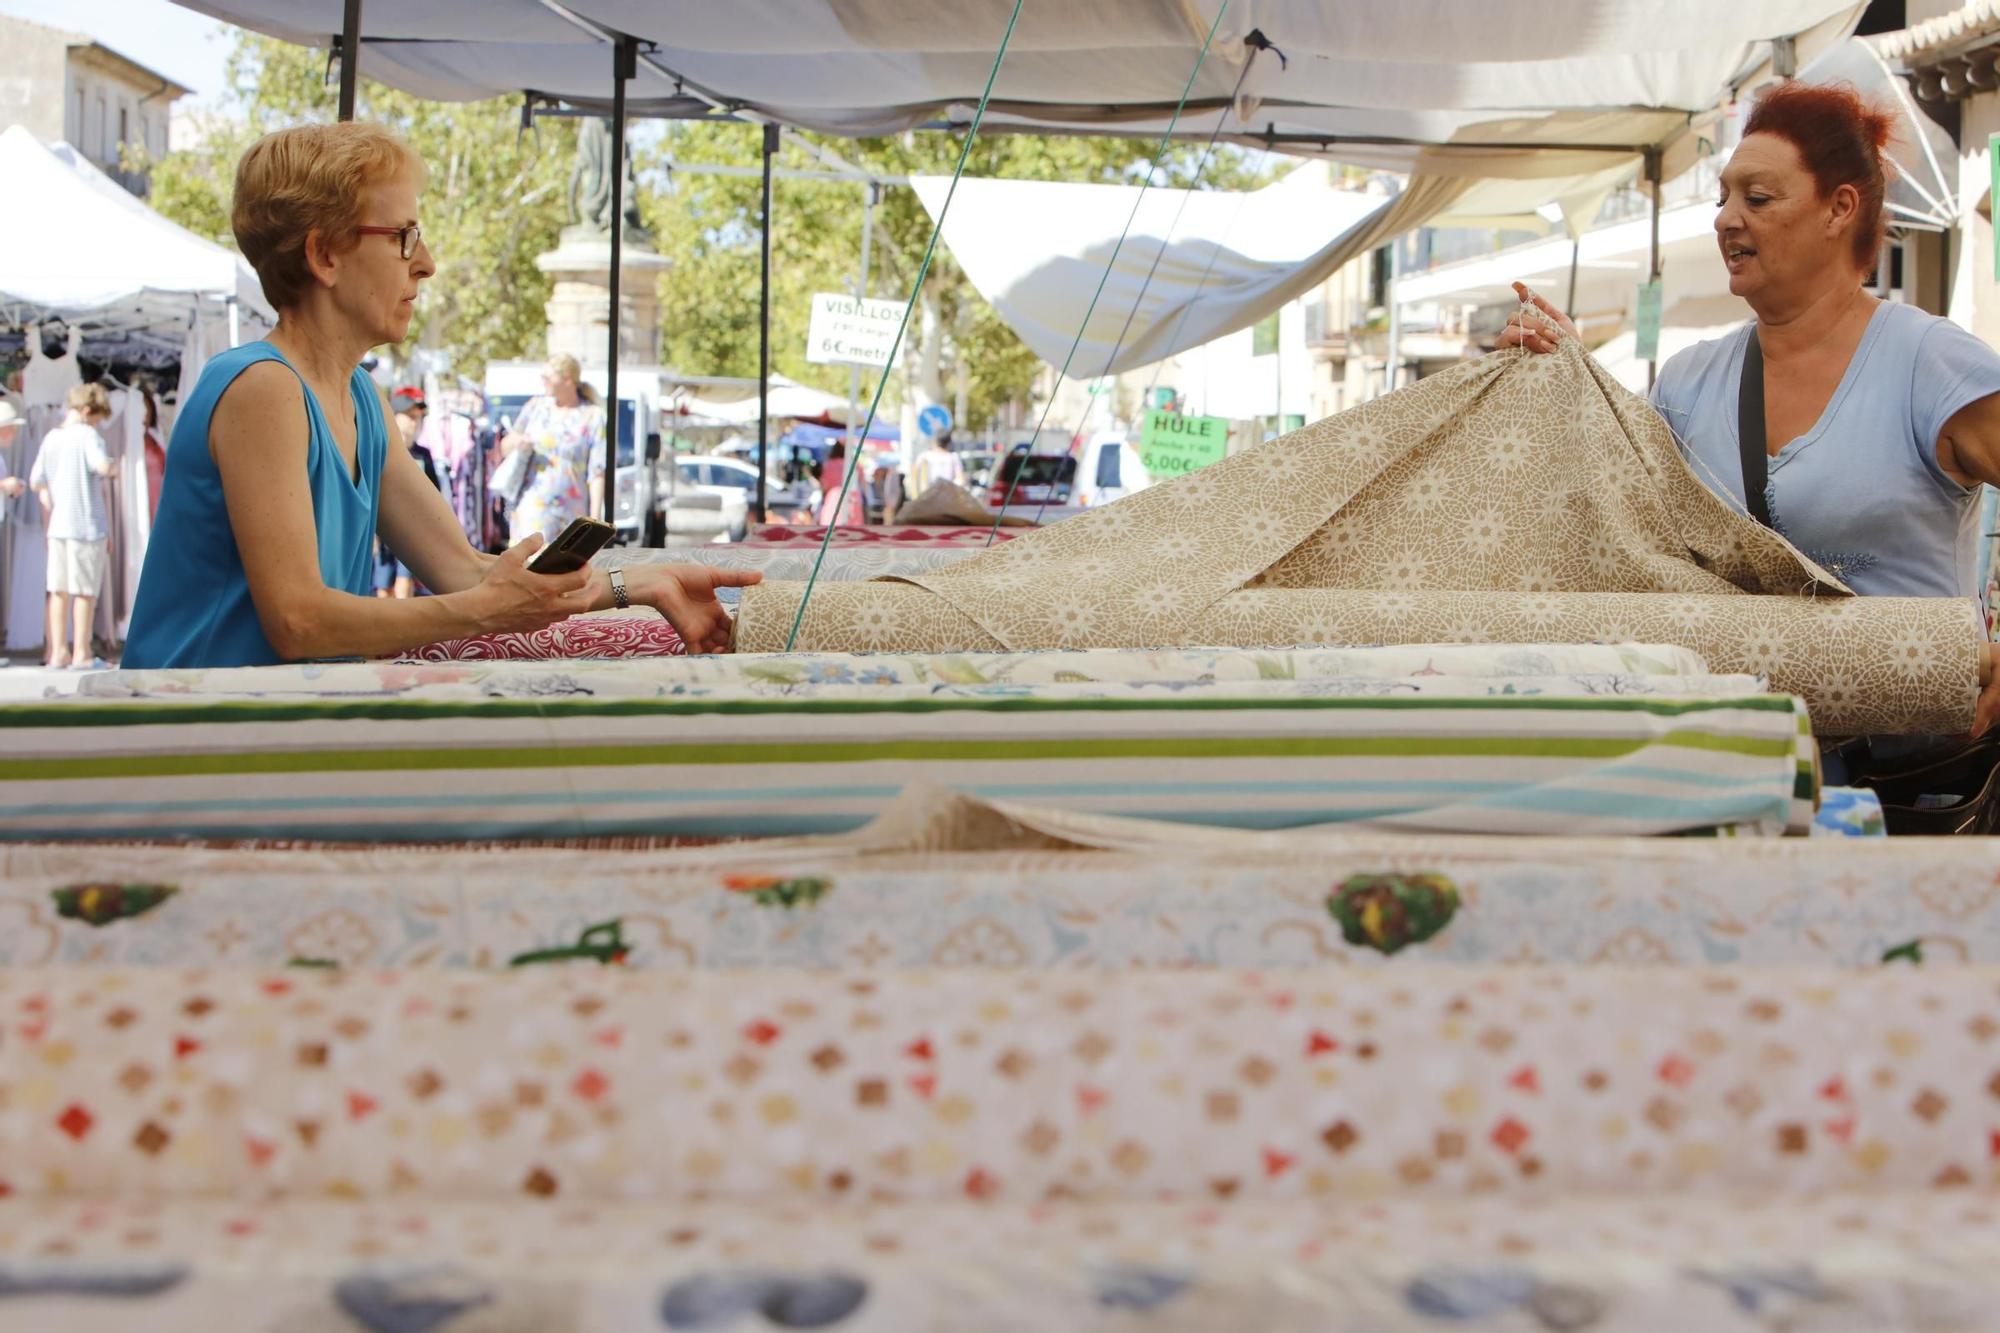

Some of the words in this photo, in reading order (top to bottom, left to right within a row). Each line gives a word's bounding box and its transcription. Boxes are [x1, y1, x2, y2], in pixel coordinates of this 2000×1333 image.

[825, 299, 903, 322] VISILLOS
[848, 346, 890, 360] metr
[1152, 415, 1213, 439] HULE
